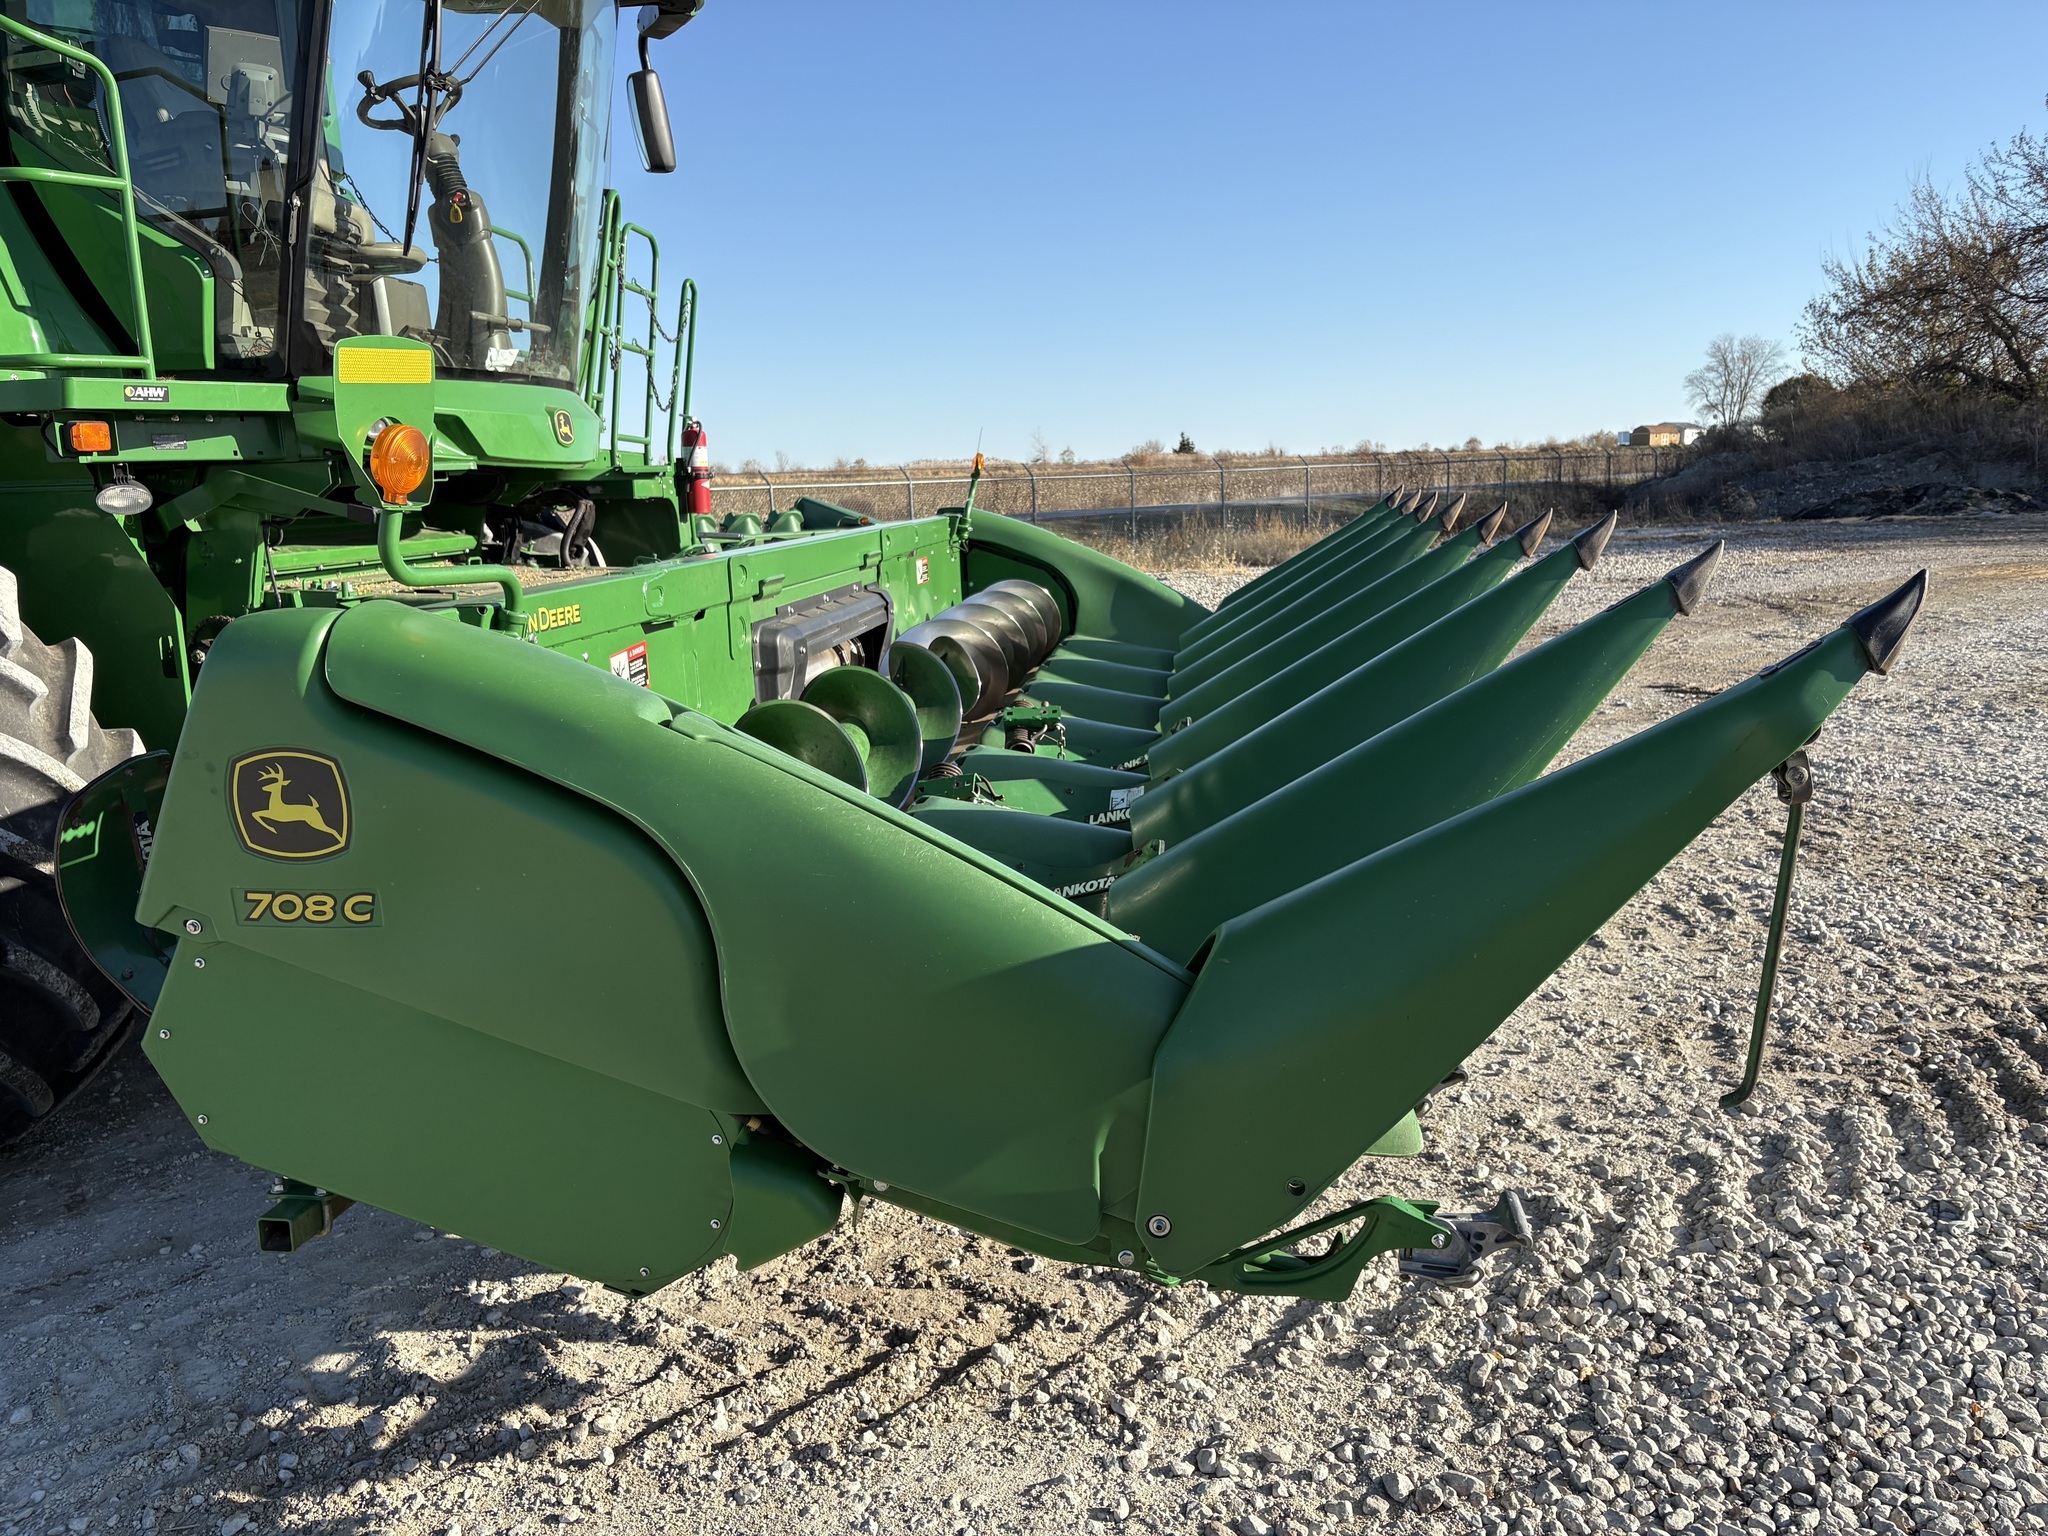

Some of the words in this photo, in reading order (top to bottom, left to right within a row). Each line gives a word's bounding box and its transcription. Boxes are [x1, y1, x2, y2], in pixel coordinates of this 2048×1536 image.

[135, 386, 165, 398] AHW
[538, 604, 582, 631] DEERE
[244, 890, 337, 924] 708
[341, 891, 376, 925] C
